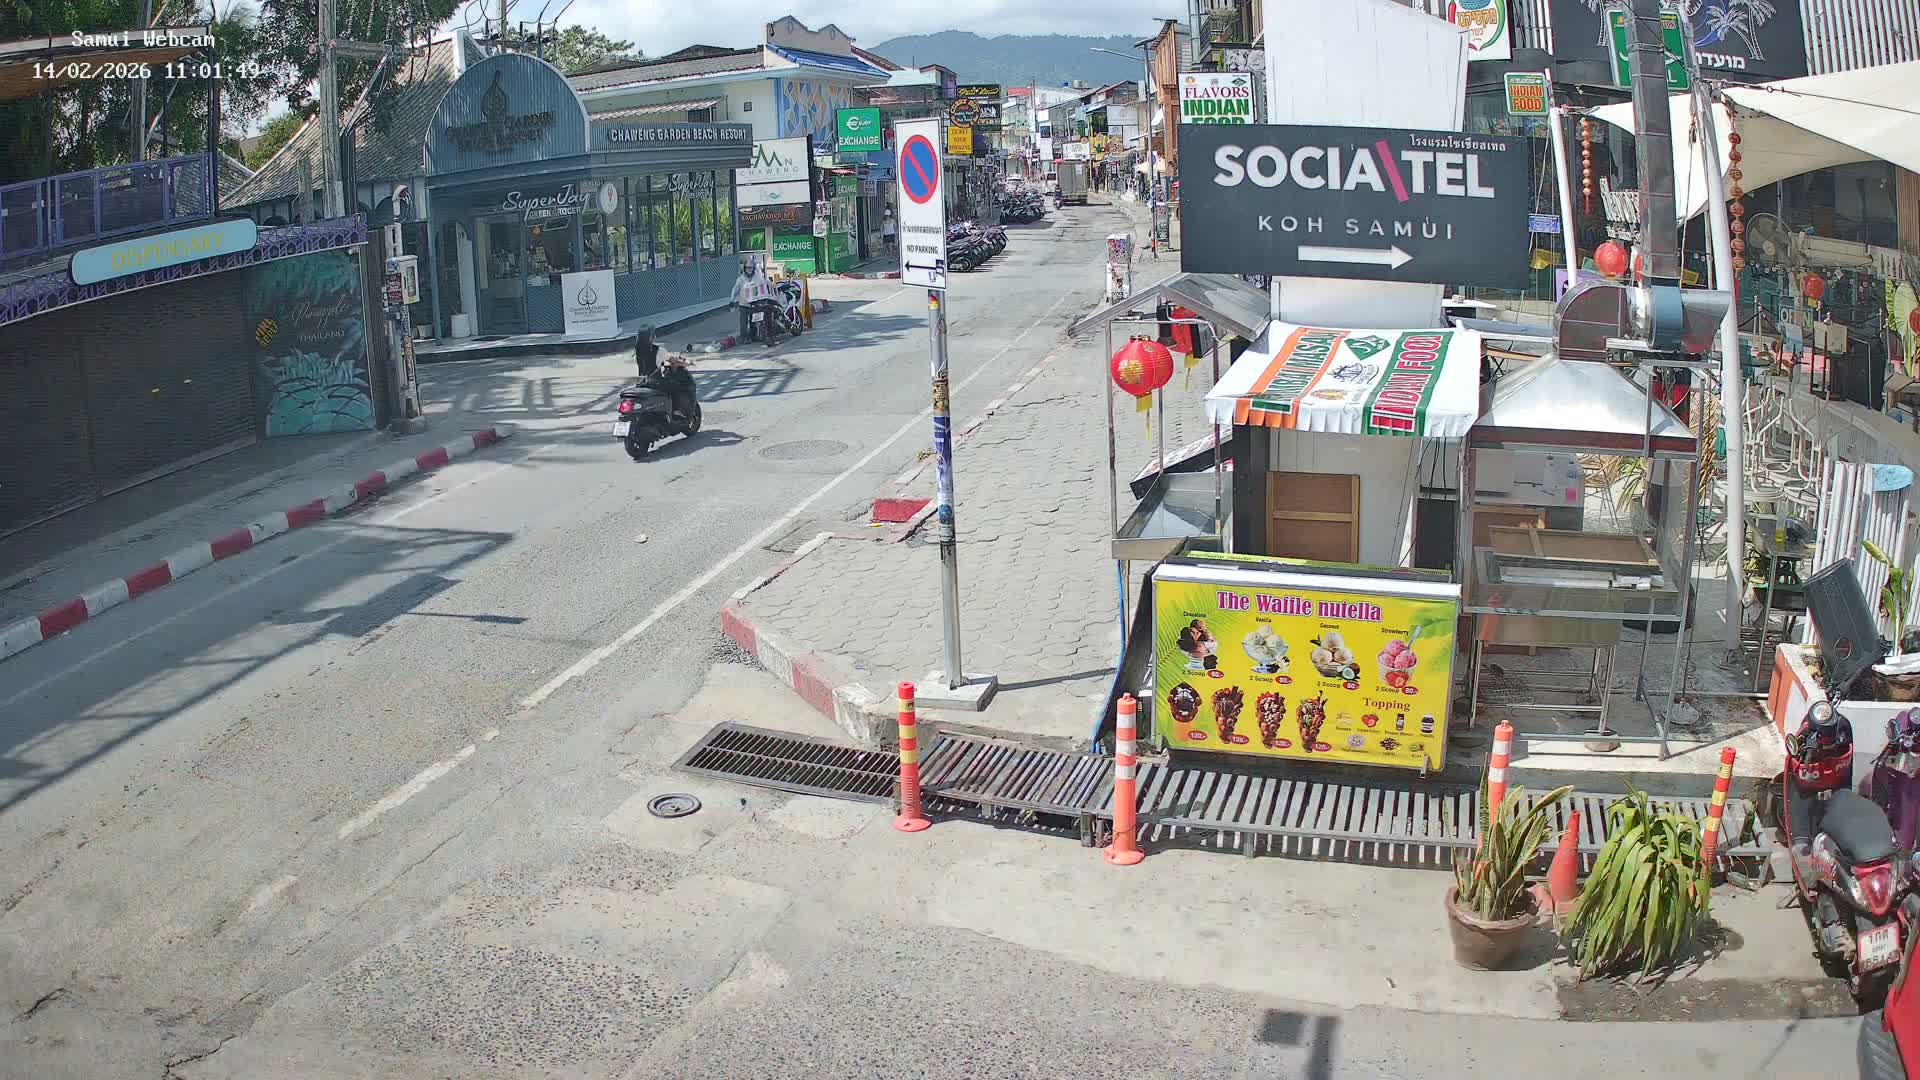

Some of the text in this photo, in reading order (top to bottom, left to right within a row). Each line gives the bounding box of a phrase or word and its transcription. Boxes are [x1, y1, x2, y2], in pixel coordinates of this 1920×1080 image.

[1185, 87, 1249, 98] FLAVORS
[1510, 85, 1543, 97] INDIAN
[1183, 99, 1249, 115] INDIAN
[1513, 97, 1542, 111] FOOD
[611, 128, 746, 141] CHAWENG GARDEN BEACH RESORT
[840, 136, 879, 146] EXCHANGE
[503, 184, 590, 221] SuperJay
[529, 210, 551, 218] GREEN
[1258, 215, 1323, 232] KOH
[111, 232, 223, 271] DISPENSARY
[773, 242, 811, 251] EXCHANGE
[915, 245, 938, 254] PARKING
[300, 329, 345, 341] THAILAND
[1217, 591, 1382, 622] The Waffle nutella
[1320, 622, 1340, 630] Coconut
[1381, 628, 1409, 636] Strawberry
[1363, 698, 1411, 711] Topping
